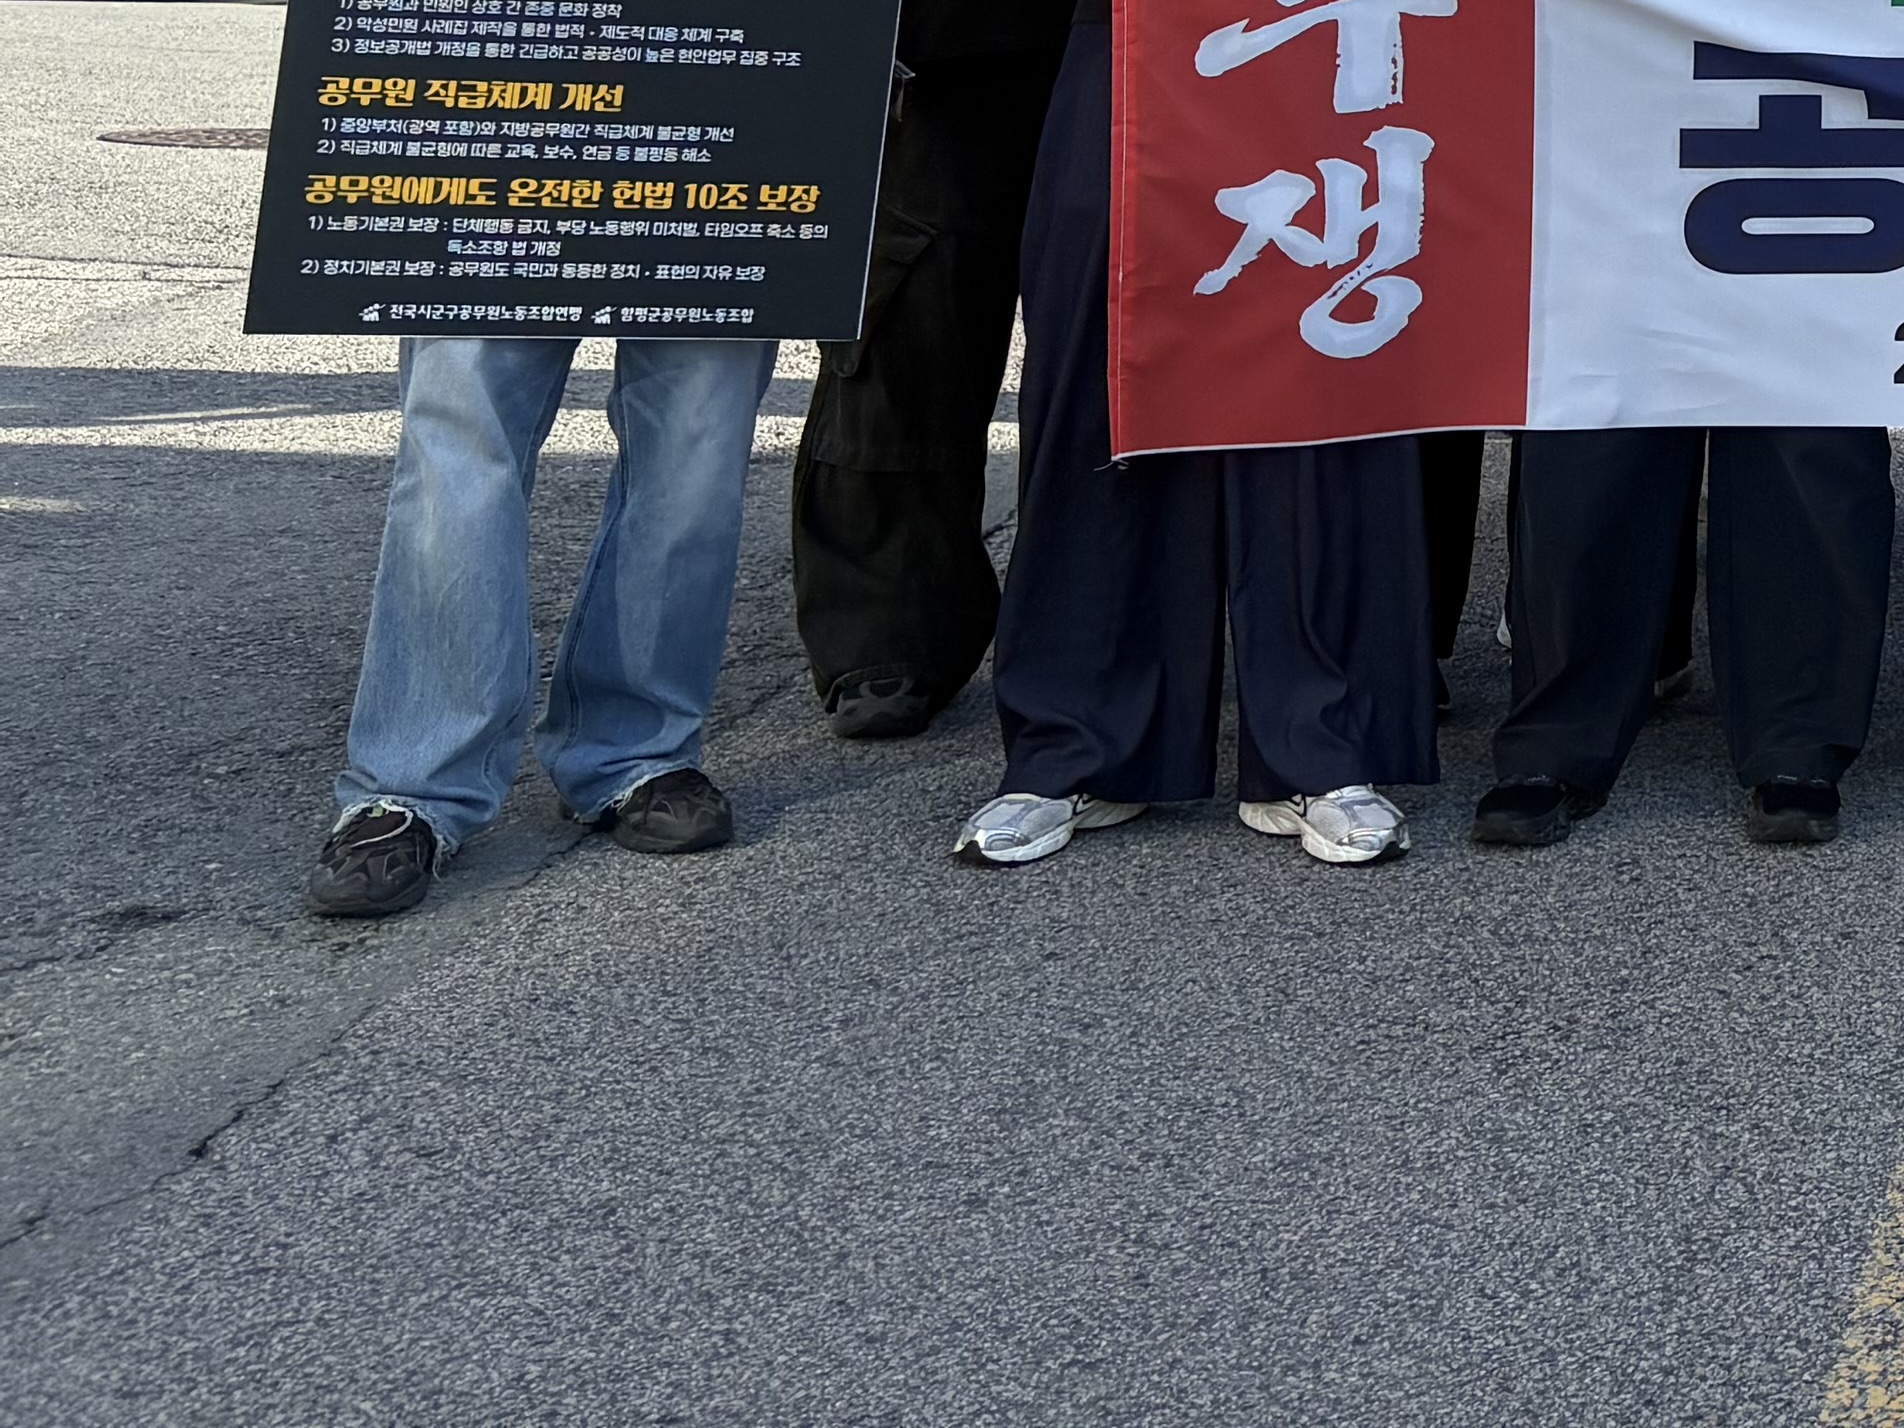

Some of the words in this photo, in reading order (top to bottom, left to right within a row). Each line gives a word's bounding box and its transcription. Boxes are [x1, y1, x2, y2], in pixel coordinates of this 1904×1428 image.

[471, 0, 504, 15] 상호
[506, 0, 522, 16] 간
[524, 1, 555, 17] 존중
[558, 1, 590, 17] 문화
[591, 3, 623, 19] 정착
[317, 76, 416, 107] 공무원
[423, 80, 553, 110] 직급체계
[559, 83, 624, 112] 개선
[321, 117, 337, 132] 1)
[339, 117, 441, 135] 중앙부처(광역
[442, 120, 497, 136] 포함)와
[499, 121, 591, 139] 지방공무원간
[593, 123, 655, 140] 직급체계
[656, 125, 702, 142] 불균형
[703, 126, 735, 142] 개선
[304, 174, 498, 205] 공무원에게도
[507, 178, 604, 208] 온전한
[612, 180, 675, 210] 헌법
[684, 183, 749, 210] 10조
[756, 184, 821, 213] 보장
[389, 304, 583, 322] 전국시군구공무원노동조합연맹
[620, 306, 754, 324] 함평군공무원노동조합
